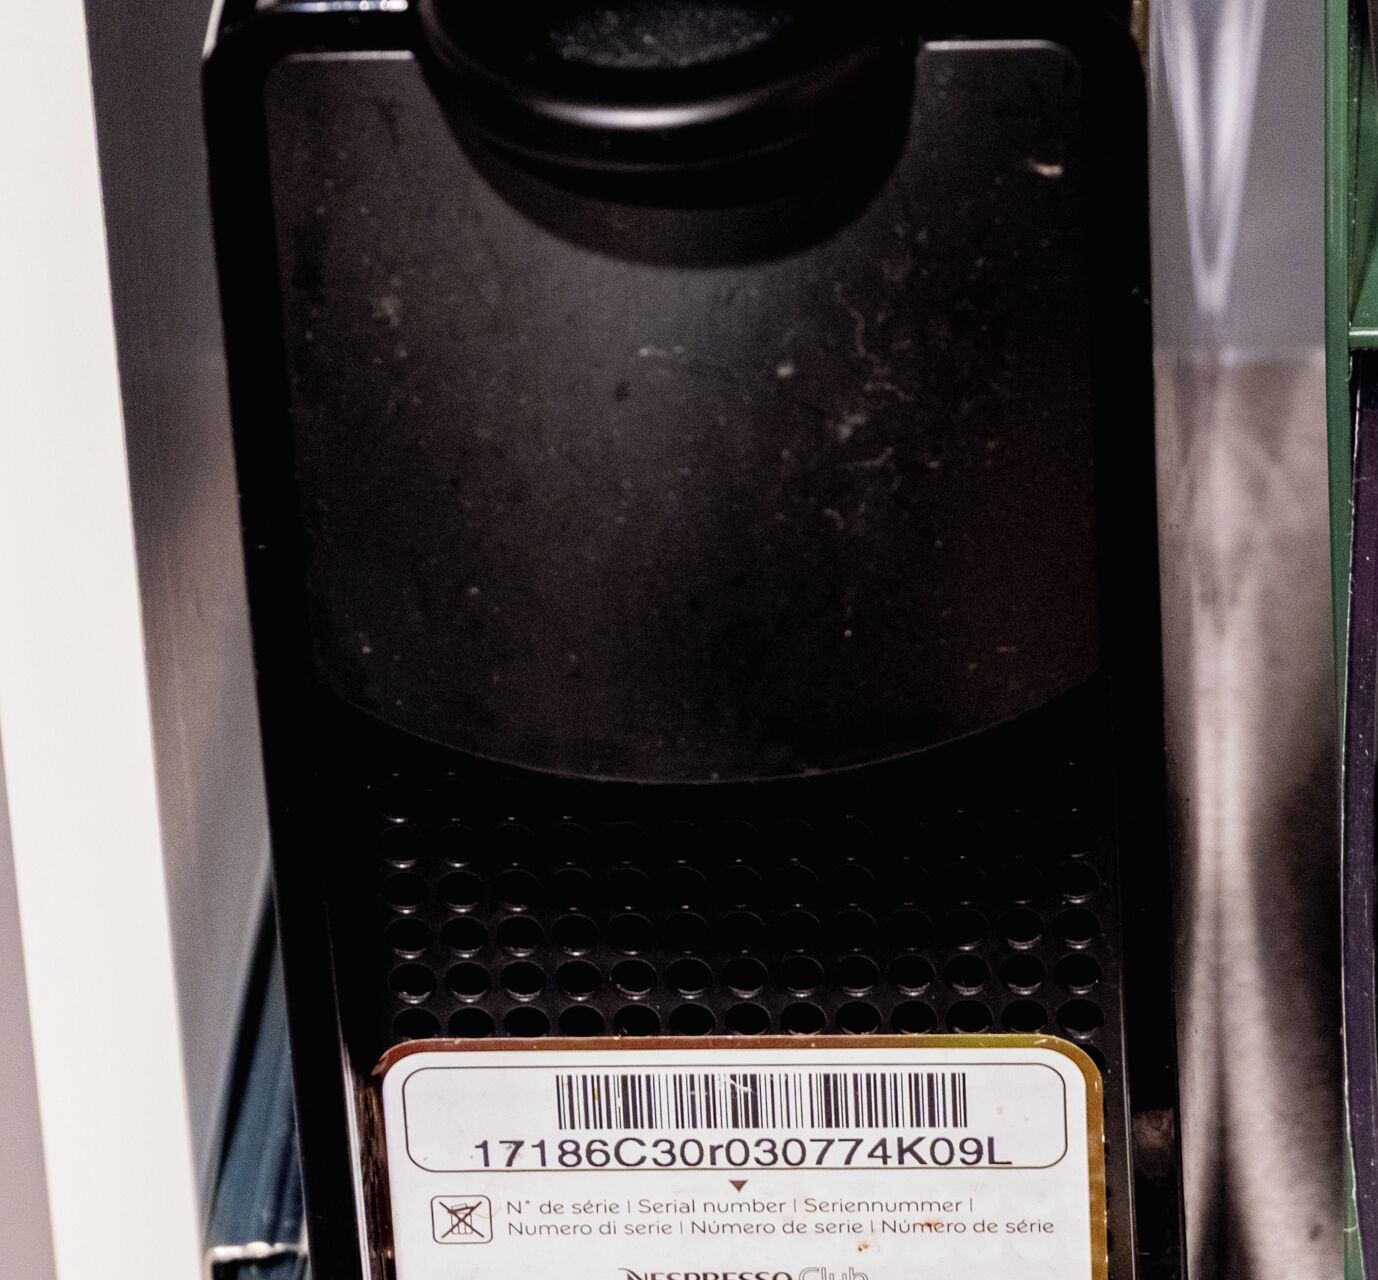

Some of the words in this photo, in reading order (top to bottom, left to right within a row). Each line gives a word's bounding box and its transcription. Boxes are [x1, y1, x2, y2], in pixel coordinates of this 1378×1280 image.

[474, 1136, 1013, 1167] 17186C30r030774K09L
[539, 1199, 565, 1215] de
[571, 1199, 620, 1214] série
[638, 1198, 696, 1214] Serial
[703, 1198, 786, 1214] number
[804, 1197, 963, 1213] Seriennummer
[508, 1221, 592, 1236] Numero
[599, 1220, 617, 1236] di
[624, 1220, 672, 1235] serie
[691, 1219, 775, 1234] Número
[782, 1219, 808, 1234] de
[815, 1219, 863, 1234] serie
[881, 1218, 966, 1234] Número
[973, 1218, 999, 1233] de
[1005, 1218, 1055, 1234] série
